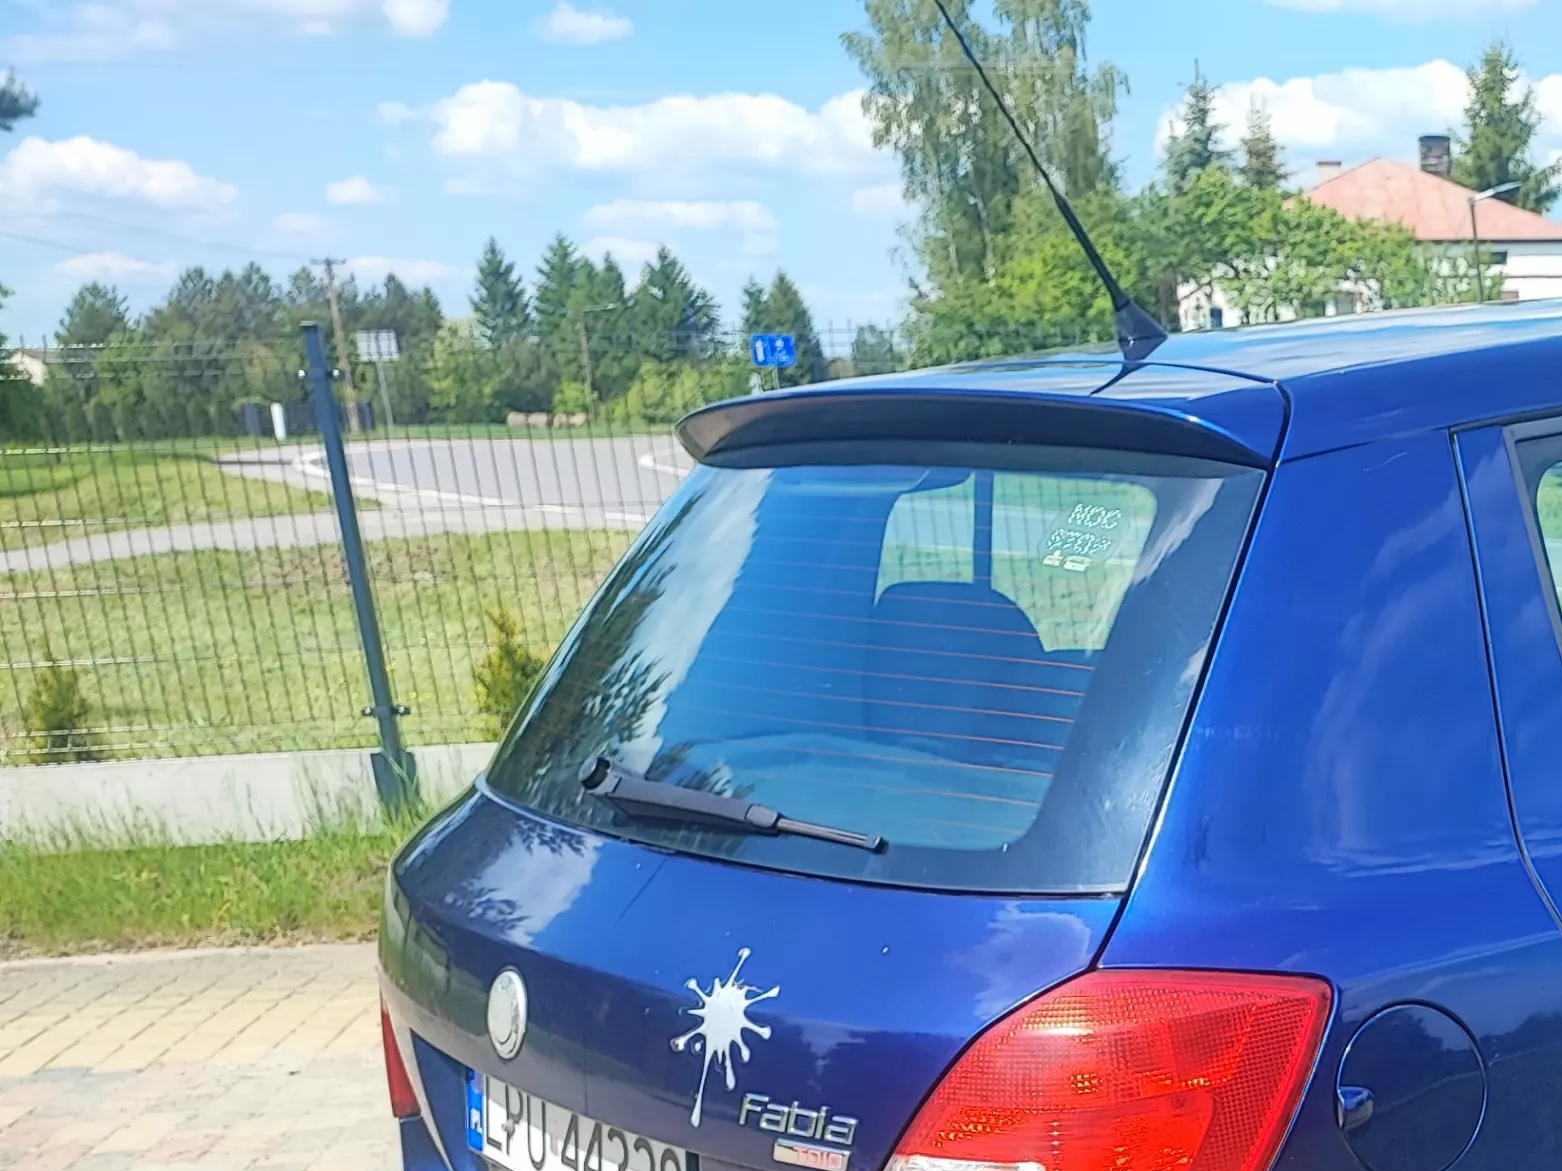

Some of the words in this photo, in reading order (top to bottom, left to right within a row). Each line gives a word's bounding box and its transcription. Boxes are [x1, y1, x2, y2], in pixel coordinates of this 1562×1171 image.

[469, 1107, 483, 1134] PL
[486, 1074, 547, 1171] LPU
[739, 1092, 858, 1145] Fabia
